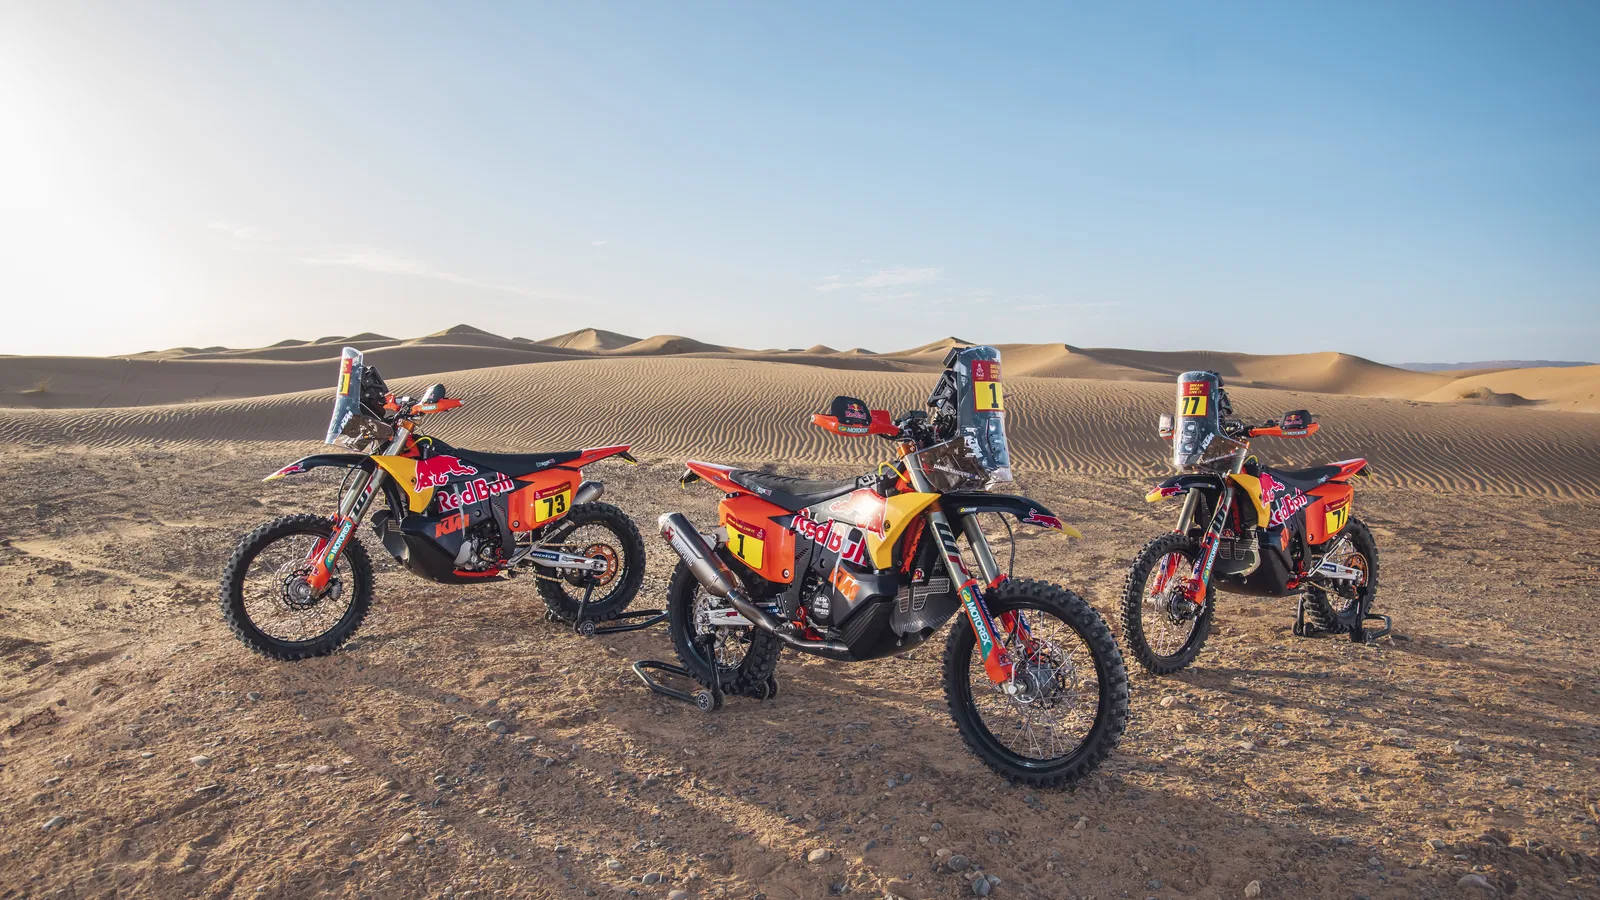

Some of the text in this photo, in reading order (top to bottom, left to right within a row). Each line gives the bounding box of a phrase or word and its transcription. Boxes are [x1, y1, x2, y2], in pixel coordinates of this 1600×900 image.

[989, 383, 999, 408] 1
[1182, 397, 1200, 414] 77
[1200, 432, 1215, 450] KTM
[933, 464, 971, 478] DANIEL SANDERS
[437, 472, 516, 514] Red Bull
[543, 494, 566, 517] 73
[435, 513, 470, 539] KTM
[790, 507, 834, 547] Red
[1333, 506, 1347, 530] 77
[331, 522, 353, 554] MOTOREX
[738, 534, 745, 560] 1
[1206, 540, 1220, 570] MOTOREX
[828, 564, 861, 601] KTM
[967, 602, 991, 646] MOTOREX
